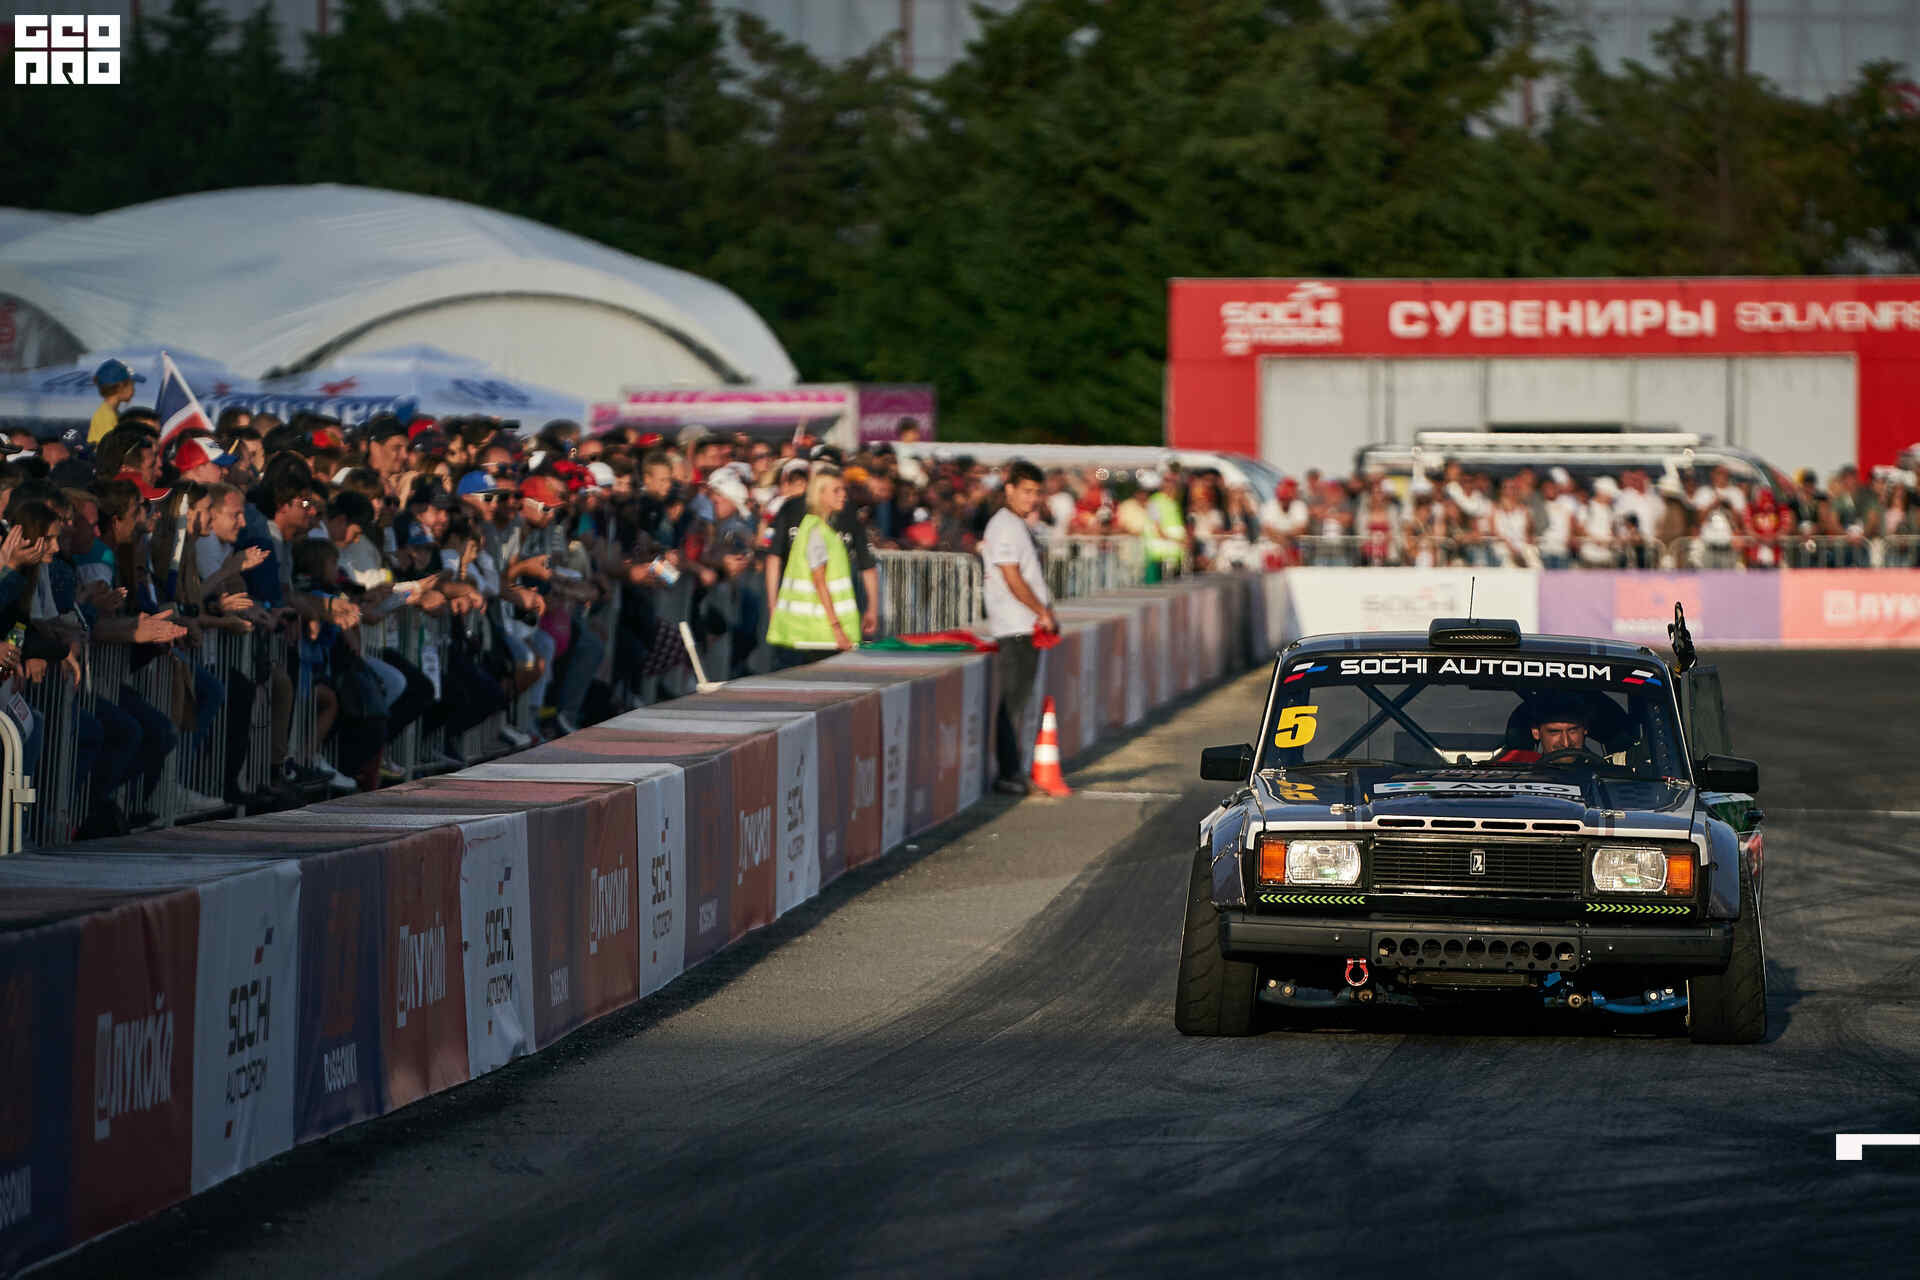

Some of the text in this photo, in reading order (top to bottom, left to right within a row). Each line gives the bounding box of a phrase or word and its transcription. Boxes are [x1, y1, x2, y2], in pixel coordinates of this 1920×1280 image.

[1388, 300, 1717, 338] СУВЕНИРЫ
[1340, 658, 1612, 681] SOCHI AUTODROM
[1274, 705, 1319, 748] 5
[1449, 783, 1571, 793] Avito
[110, 992, 174, 1119] ЛУКОЙЛ
